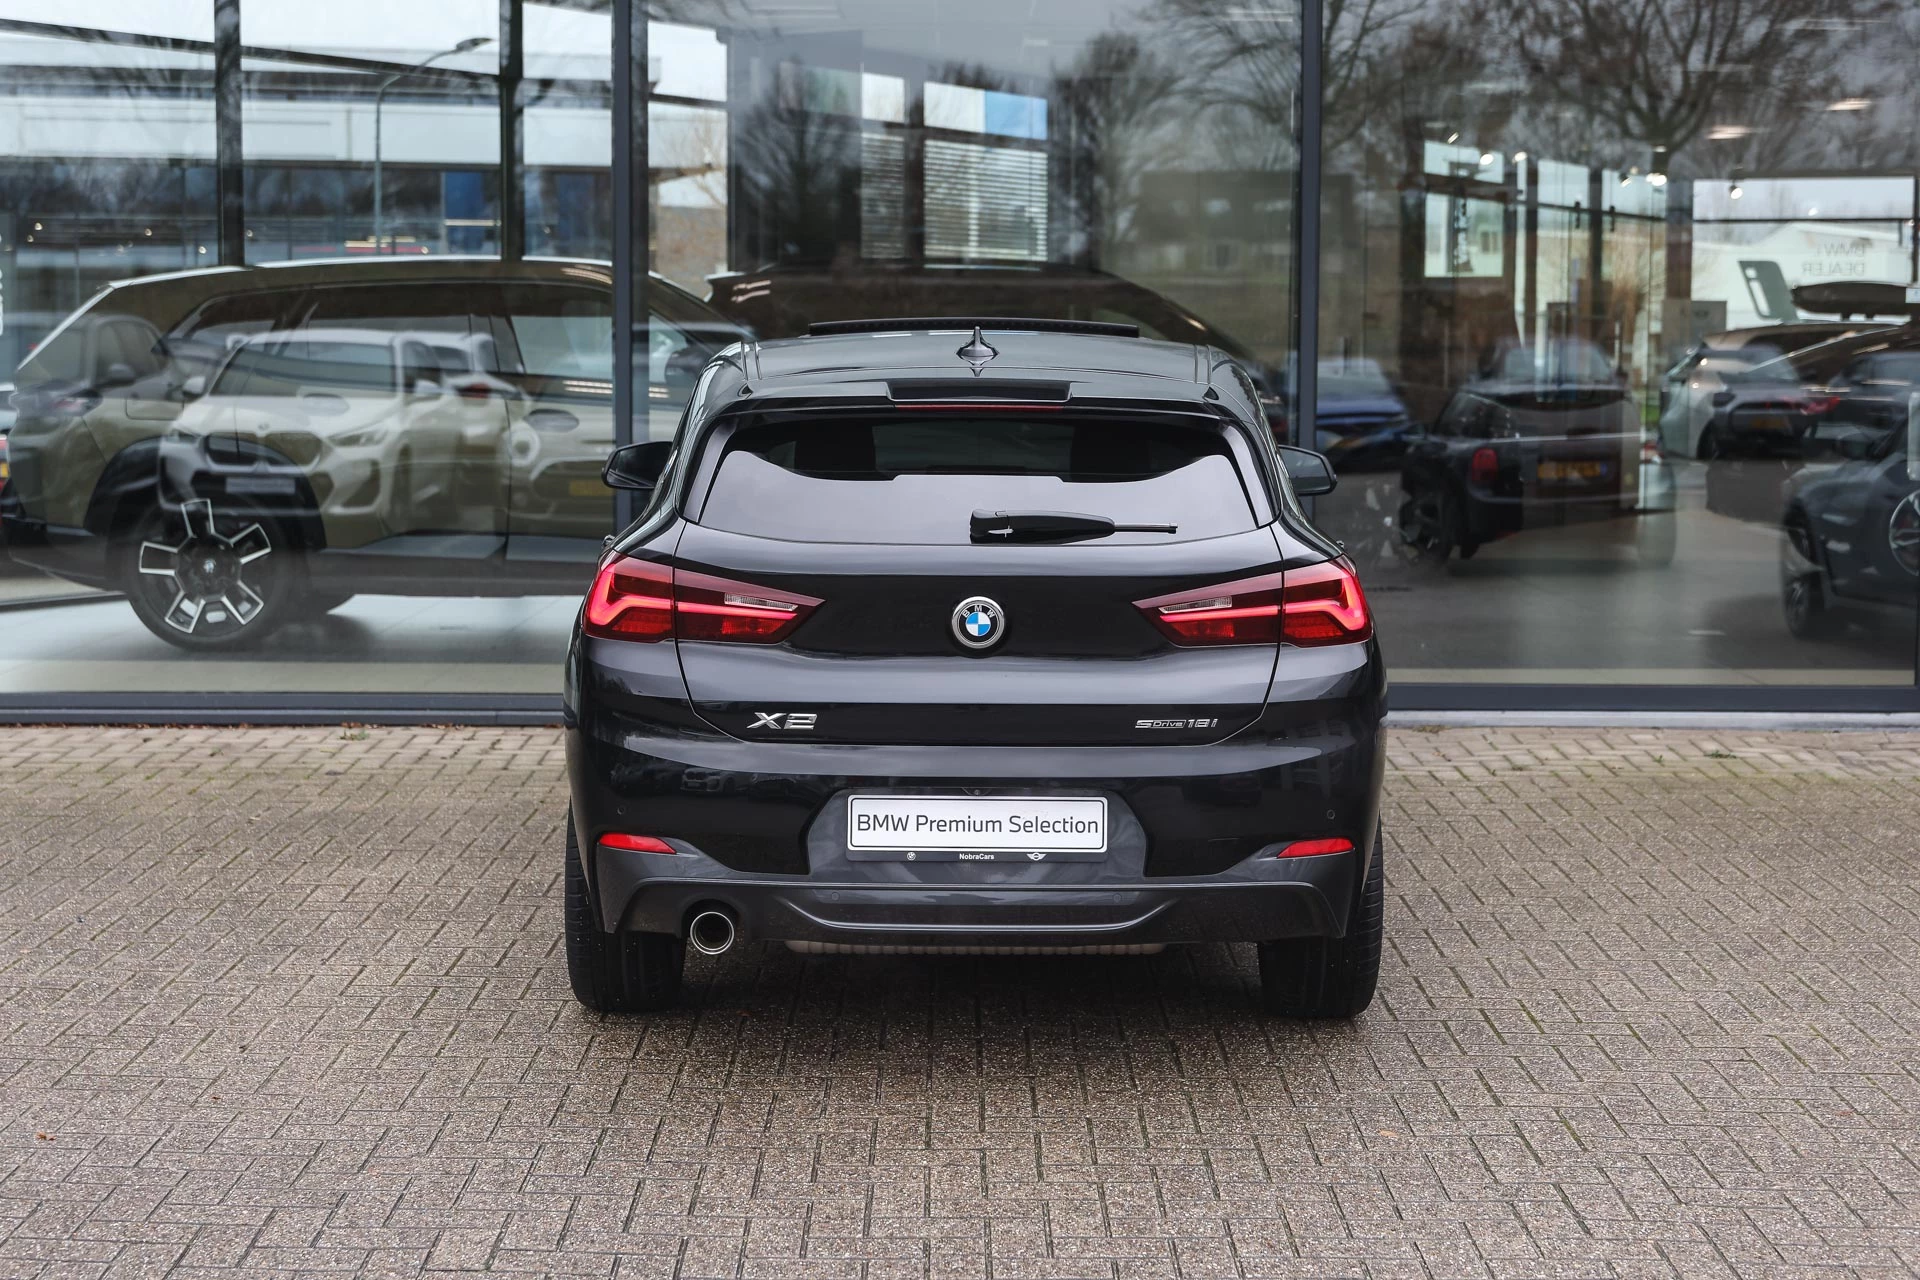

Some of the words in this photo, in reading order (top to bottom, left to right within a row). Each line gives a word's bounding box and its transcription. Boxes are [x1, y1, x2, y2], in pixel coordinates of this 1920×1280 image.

[960, 604, 997, 618] BMW
[746, 712, 818, 730] X2
[857, 813, 910, 832] BMW
[916, 814, 1003, 833] Premium
[1008, 815, 1099, 834] Selection
